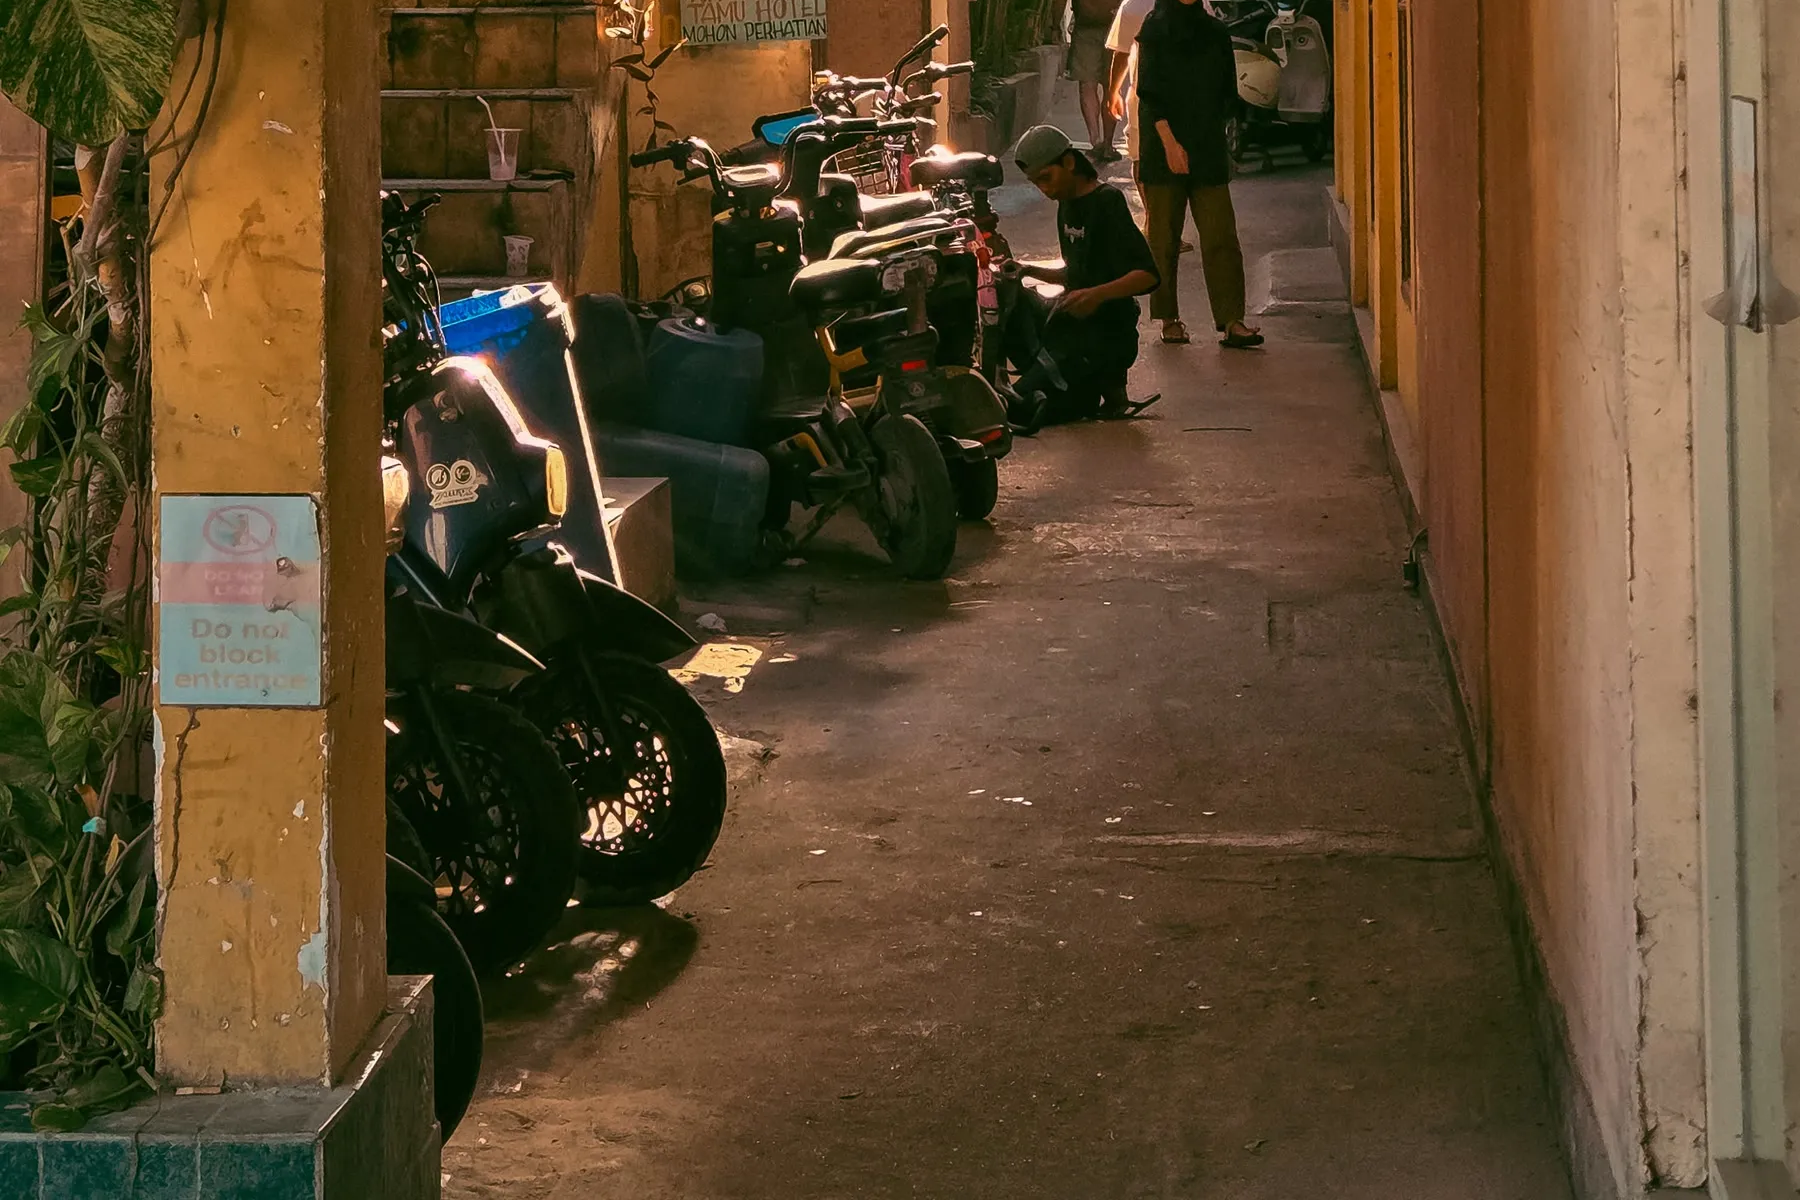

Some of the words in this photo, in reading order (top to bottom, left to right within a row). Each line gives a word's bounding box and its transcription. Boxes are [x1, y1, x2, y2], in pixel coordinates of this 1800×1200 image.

[687, 1, 745, 24] TAMU
[682, 23, 737, 43] MOHON
[744, 19, 827, 42] PERHATIAN
[192, 618, 231, 639] Do
[200, 644, 281, 664] block
[174, 668, 308, 690] entrance
